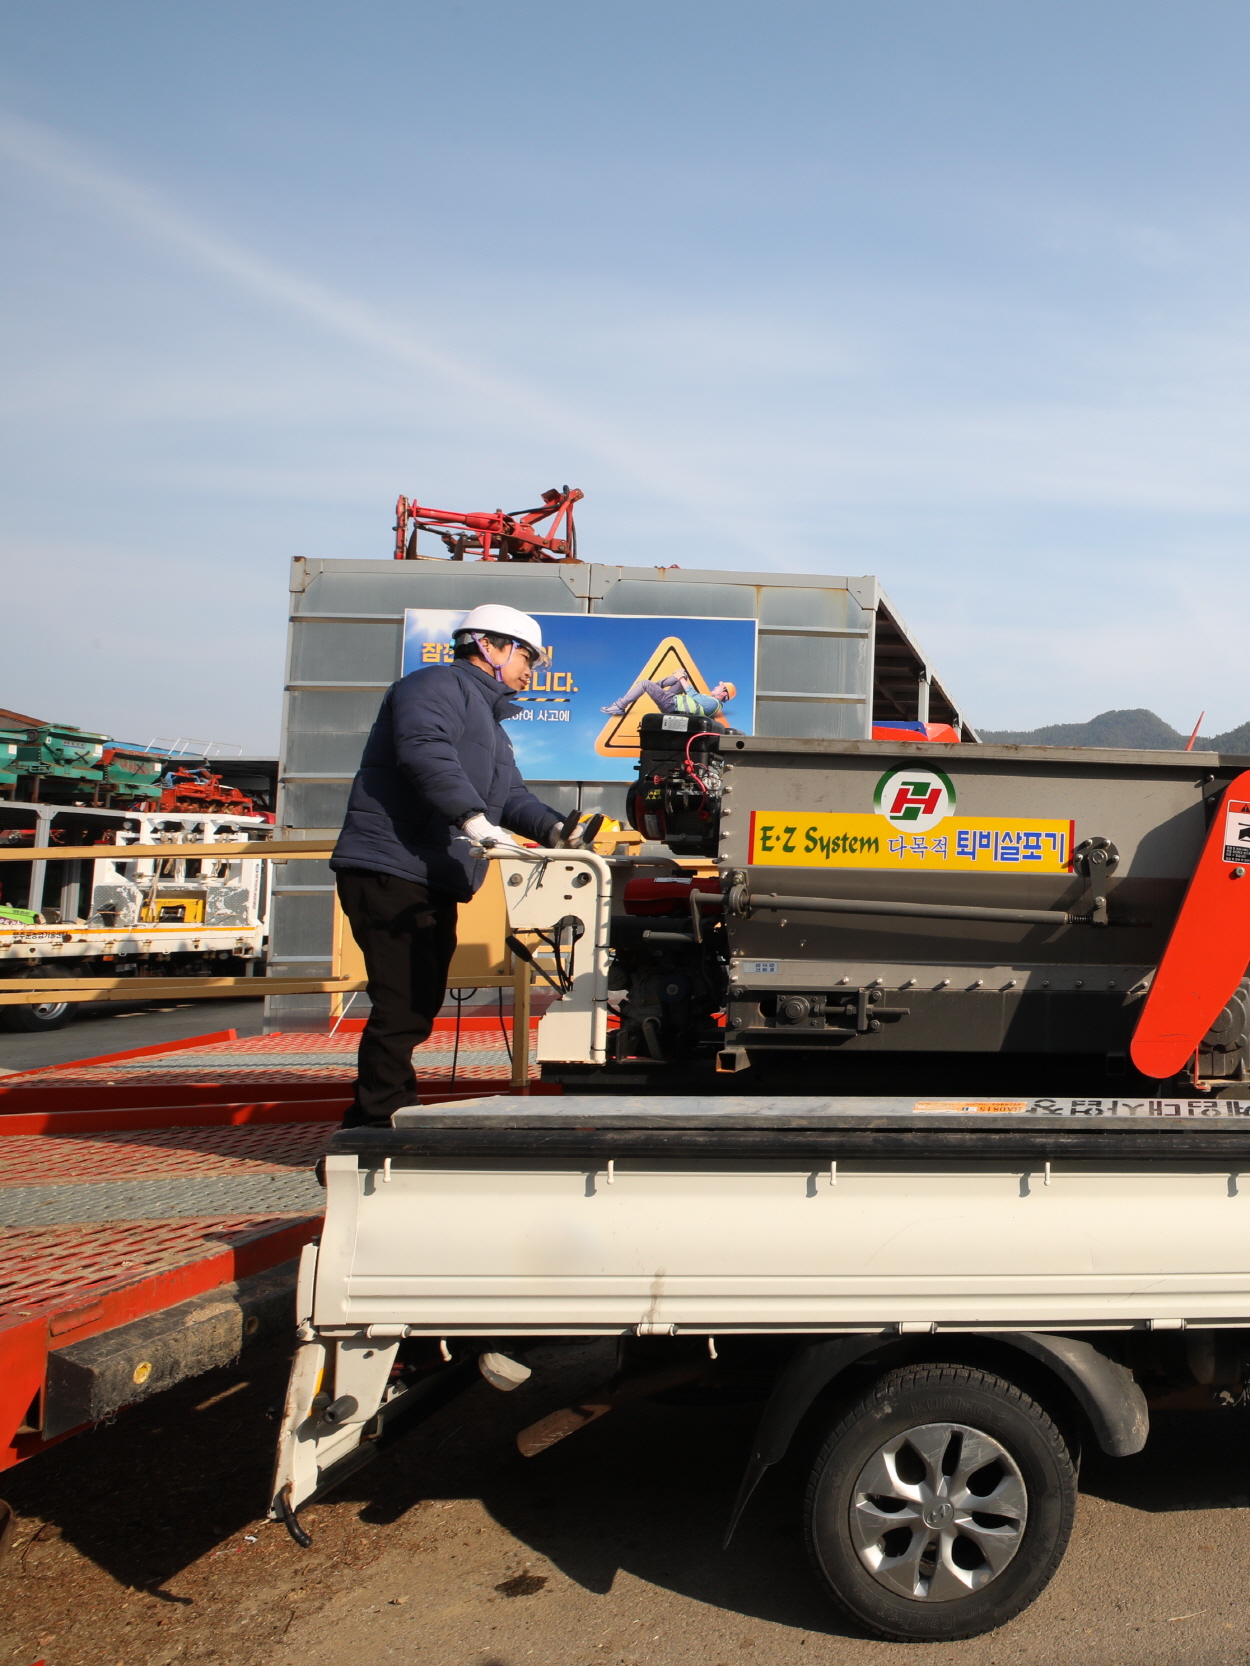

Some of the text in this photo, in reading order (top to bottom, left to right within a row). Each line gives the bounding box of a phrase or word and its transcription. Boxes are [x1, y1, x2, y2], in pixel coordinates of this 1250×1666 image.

[521, 671, 579, 692] 니다.
[536, 709, 571, 722] 사고에
[803, 826, 880, 859] System
[887, 829, 1065, 864] 다목적 퇴비살포기
[910, 1398, 993, 1420] KUMHO
